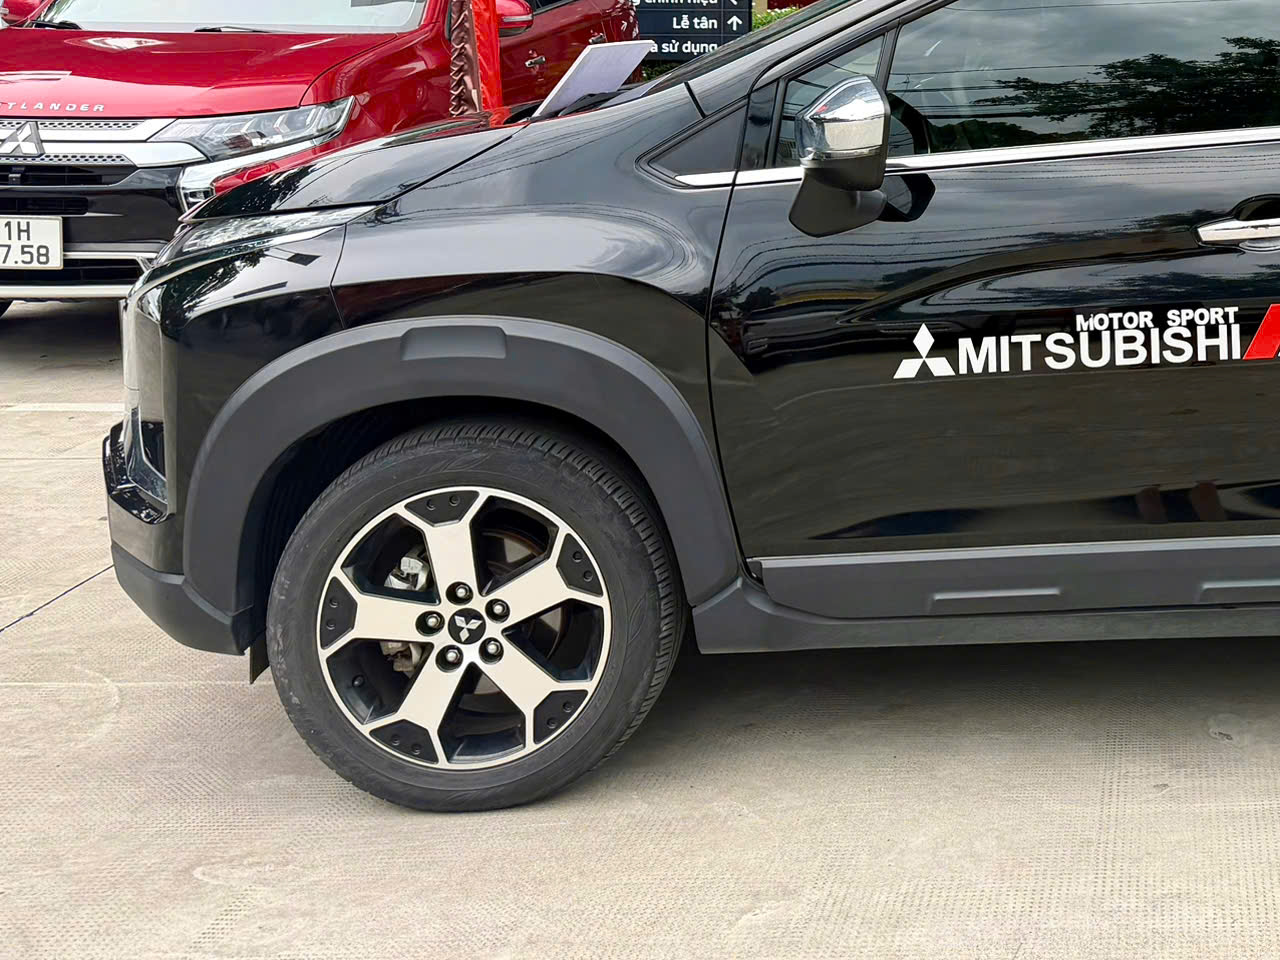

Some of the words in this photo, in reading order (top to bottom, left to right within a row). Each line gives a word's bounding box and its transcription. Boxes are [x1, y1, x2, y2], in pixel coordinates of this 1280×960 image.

[672, 14, 690, 29] Lễ
[693, 17, 718, 29] tân
[661, 40, 680, 53] sử
[0, 102, 105, 112] TLANDER
[1075, 310, 1155, 332] MOTOR
[1166, 306, 1239, 328] SPORT
[958, 323, 1241, 375] MITSUBISHI
